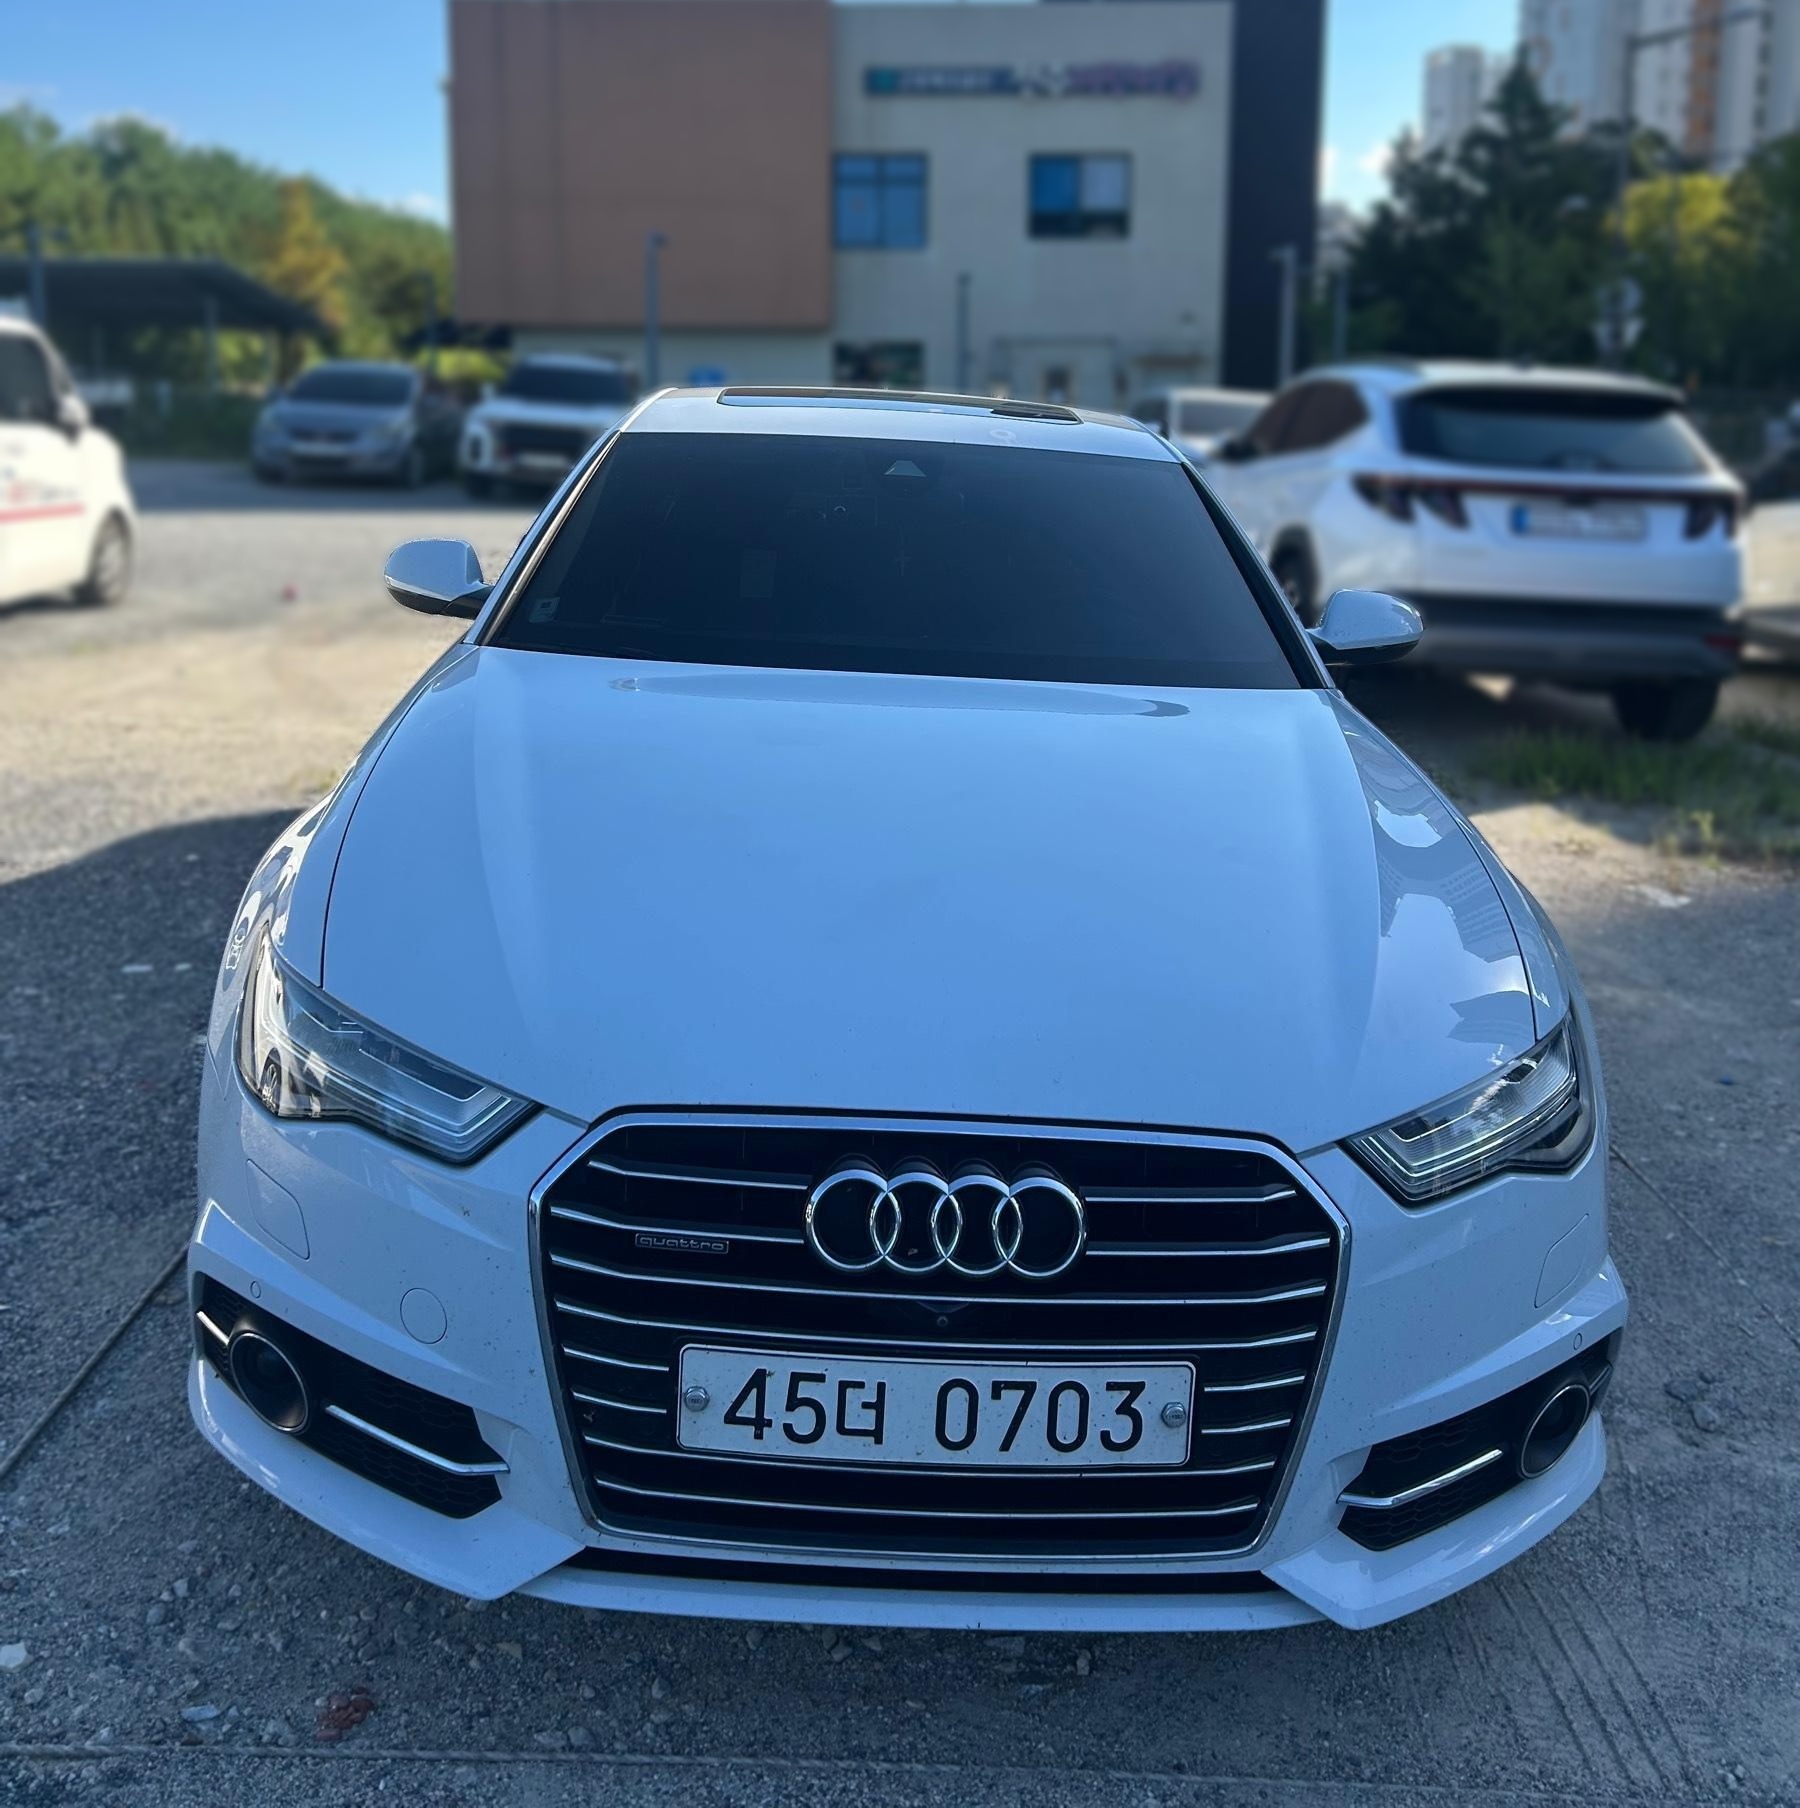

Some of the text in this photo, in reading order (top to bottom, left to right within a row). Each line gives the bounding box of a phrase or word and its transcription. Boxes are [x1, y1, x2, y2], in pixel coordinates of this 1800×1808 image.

[639, 1236, 725, 1251] quattro
[723, 1368, 1146, 1453] 45더 0703
